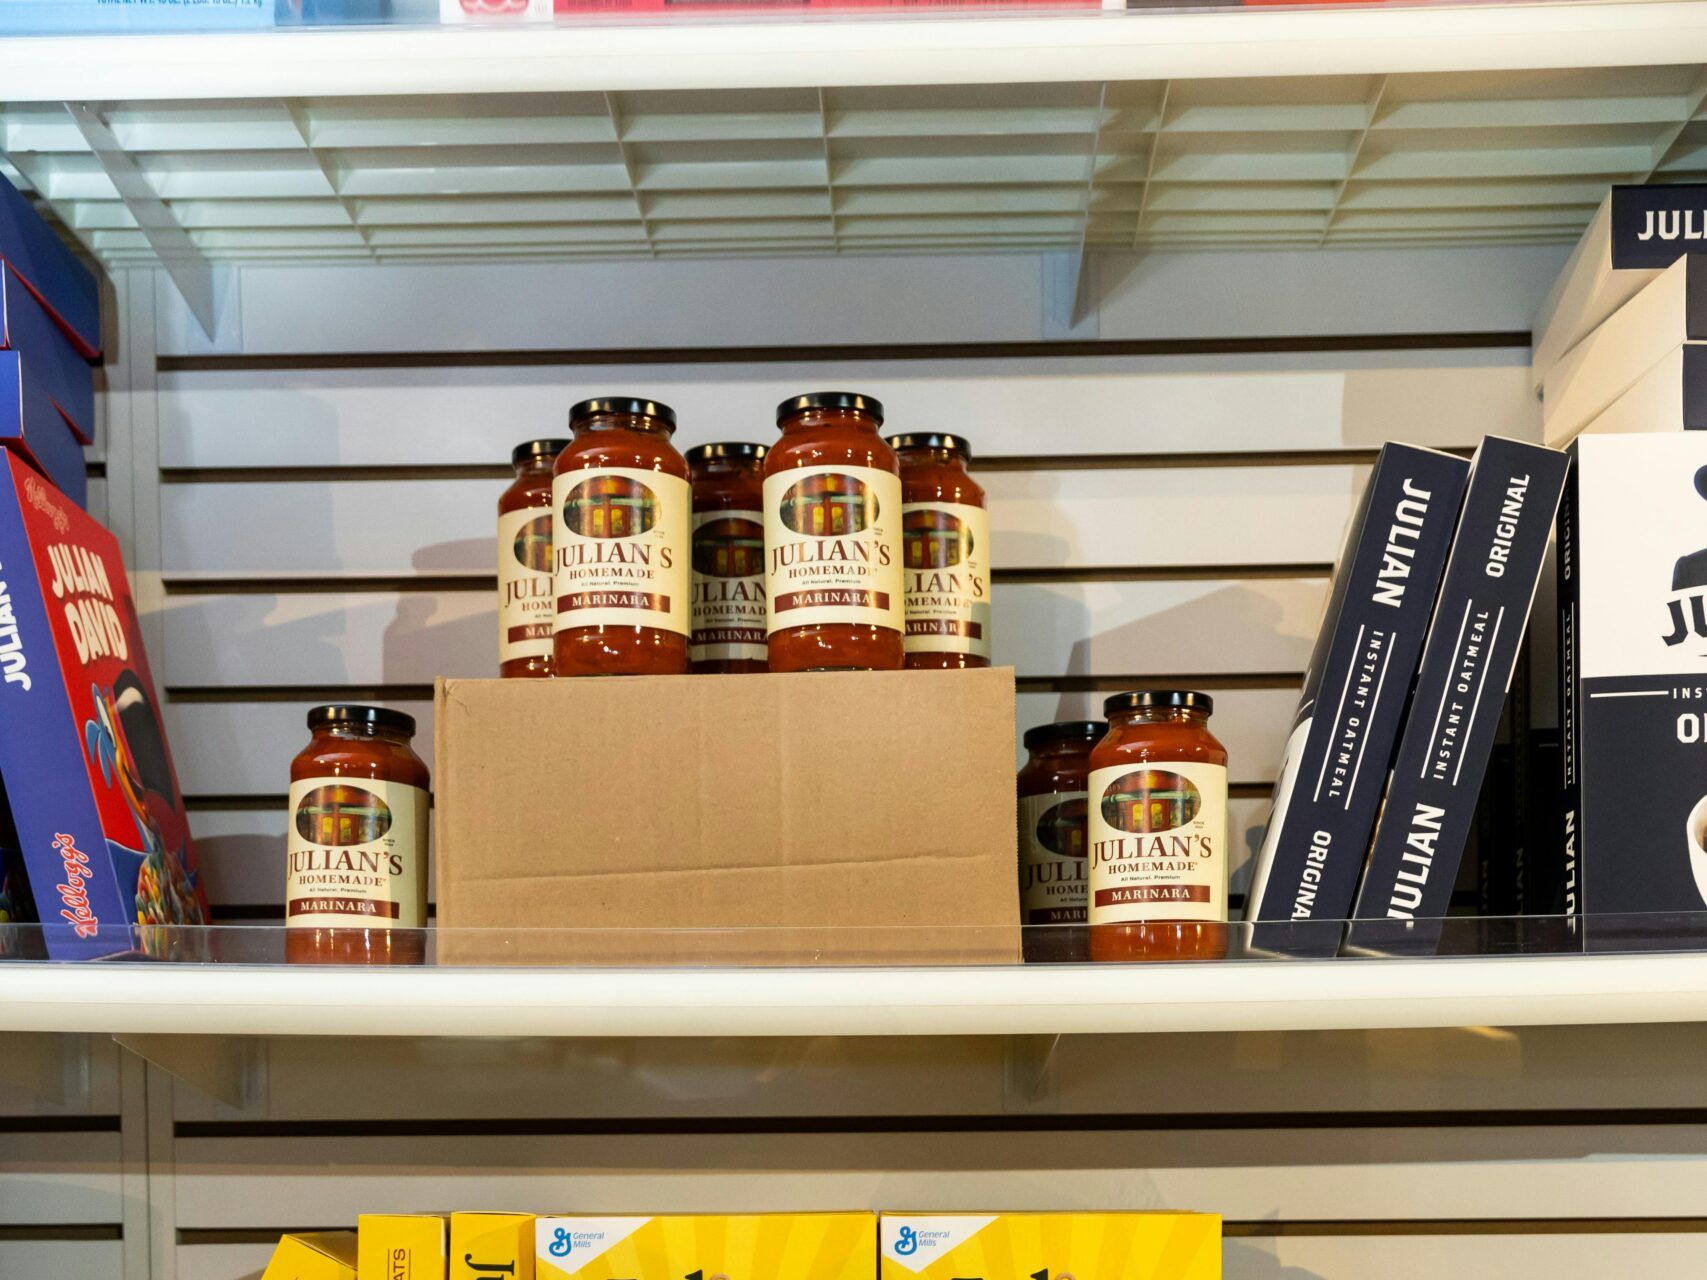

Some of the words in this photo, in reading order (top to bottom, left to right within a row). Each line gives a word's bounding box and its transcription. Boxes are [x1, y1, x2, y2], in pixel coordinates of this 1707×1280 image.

[1638, 210, 1707, 240] JULI
[1485, 473, 1530, 578] ORIGINAL
[772, 540, 890, 576] JULIAN'S
[1372, 478, 1432, 608] JULIAN
[48, 543, 114, 601] JULIAN
[556, 542, 672, 576] JULIANS
[570, 568, 654, 580] HOMEMADE
[572, 594, 650, 606] MARINARA
[792, 592, 870, 604] MARINARA
[904, 572, 983, 598] LIAN'S
[694, 604, 767, 616] HOMEMAD
[64, 598, 128, 664] DAVID
[1354, 630, 1384, 709] INSTANT
[1433, 702, 1464, 780] INSTANT
[1458, 610, 1488, 694] OATMEAL
[1328, 716, 1360, 798] OATMEAL
[288, 850, 402, 880] JULIAN'S
[1092, 835, 1212, 870] JULIAN'S
[299, 874, 384, 887] HOMEMADE
[1108, 862, 1196, 874] HOMEMADE
[1290, 830, 1332, 921] ORIGINA
[56, 832, 98, 938] Kellogg's
[1111, 886, 1190, 902] MARINARA
[300, 901, 377, 913] MARINARA
[573, 1232, 604, 1240] General
[918, 1230, 950, 1238] General
